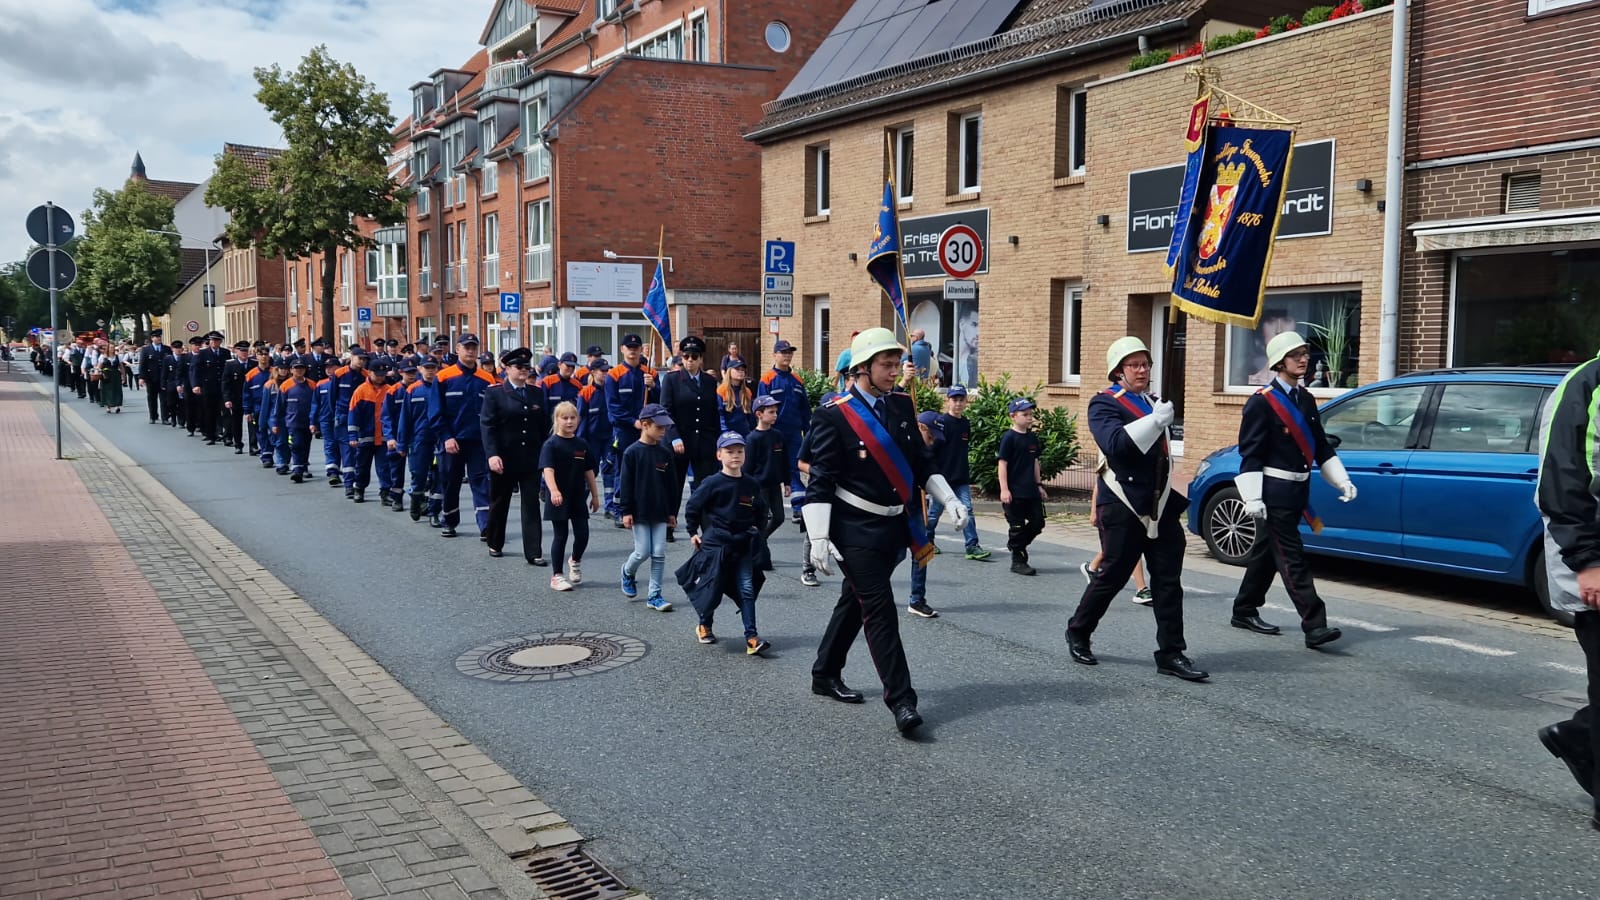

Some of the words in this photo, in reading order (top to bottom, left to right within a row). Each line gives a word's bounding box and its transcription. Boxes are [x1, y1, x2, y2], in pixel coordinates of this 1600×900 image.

[1281, 193, 1324, 215] rdt
[1236, 212, 1263, 227] 1876
[904, 232, 941, 247] Frise
[770, 245, 786, 269] P
[902, 253, 915, 264] an
[918, 250, 938, 262] Tra
[948, 240, 973, 264] 30
[947, 285, 974, 294] Altenheim
[504, 295, 516, 310] P
